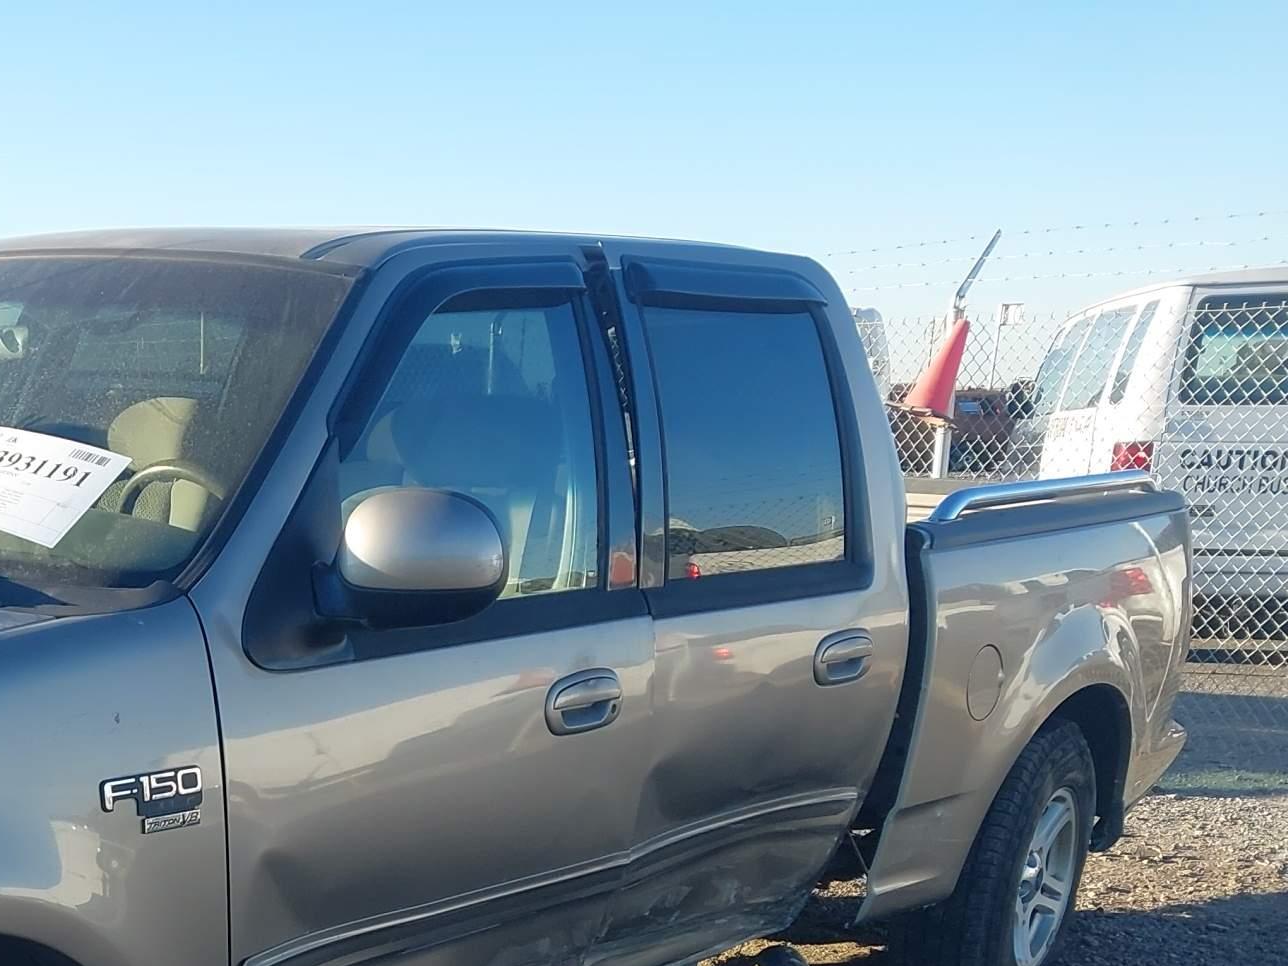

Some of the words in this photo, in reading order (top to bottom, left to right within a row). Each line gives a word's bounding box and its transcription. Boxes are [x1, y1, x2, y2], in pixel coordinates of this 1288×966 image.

[1183, 475, 1253, 495] CHURCH
[103, 767, 203, 811] F-150
[147, 817, 180, 831] TRITON
[181, 811, 200, 826] V8
